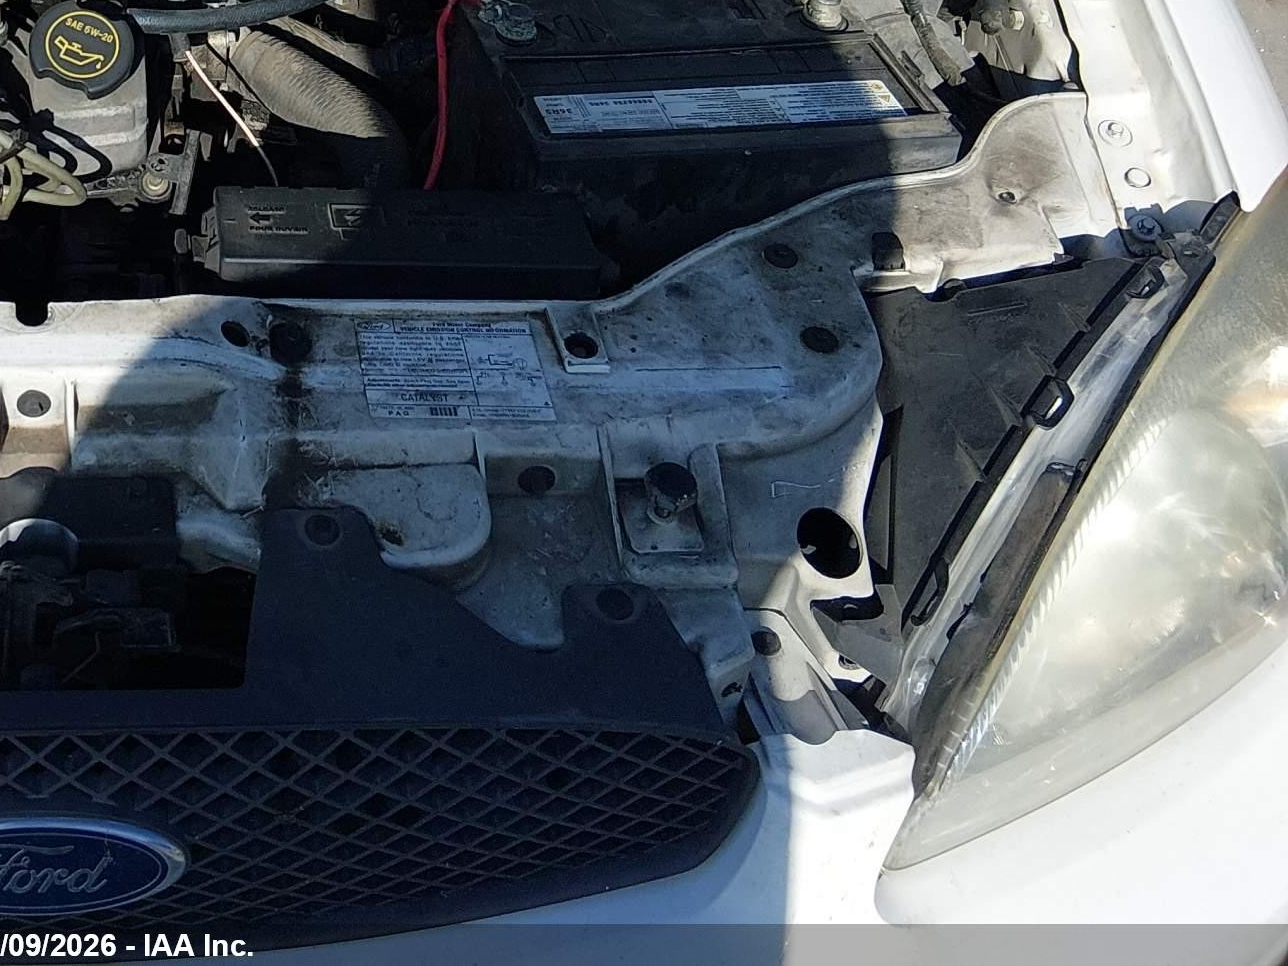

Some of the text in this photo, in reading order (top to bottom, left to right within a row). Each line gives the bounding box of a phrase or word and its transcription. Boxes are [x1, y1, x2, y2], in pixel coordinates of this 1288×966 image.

[65, 18, 113, 43] SAE 5W-20
[400, 393, 449, 402] CATALYST
